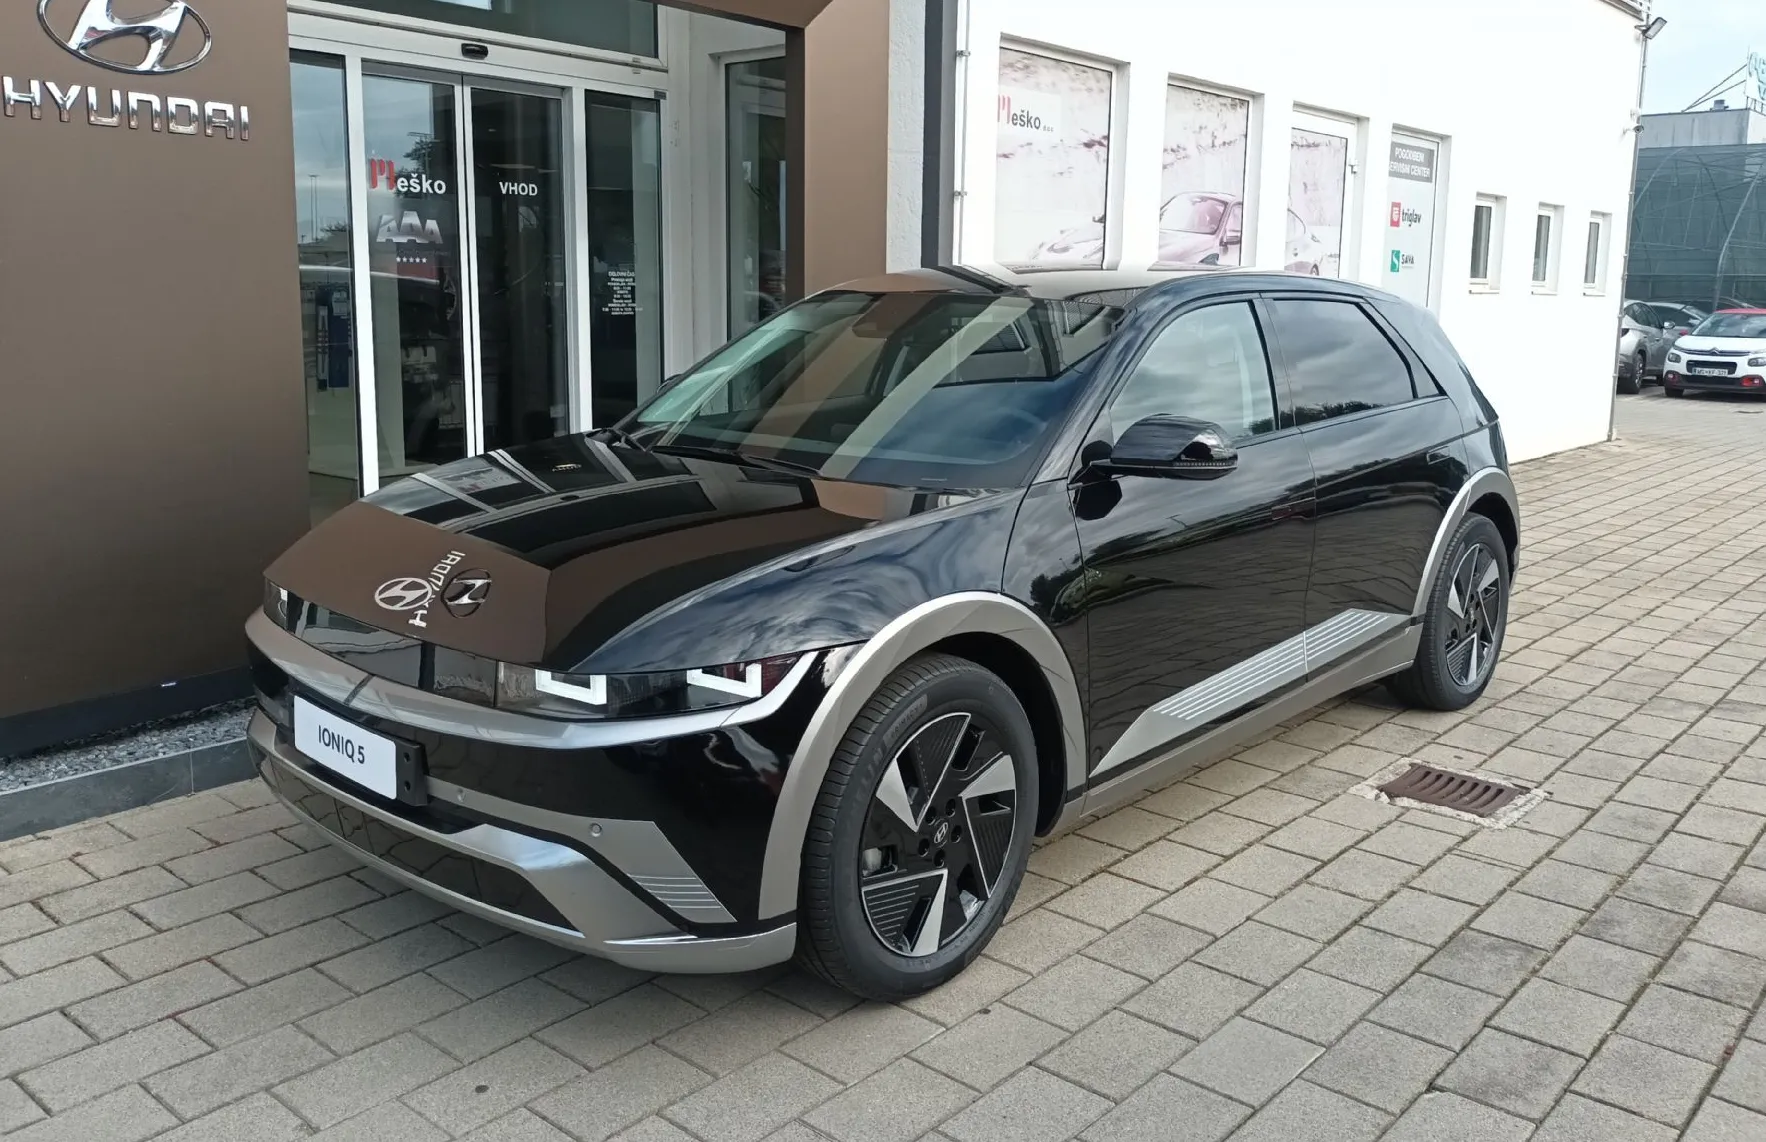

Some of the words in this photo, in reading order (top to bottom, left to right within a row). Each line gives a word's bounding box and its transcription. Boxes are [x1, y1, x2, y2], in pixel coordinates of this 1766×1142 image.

[1, 75, 249, 141] HYUNDAI
[370, 158, 447, 195] Meško
[499, 181, 538, 196] VHOD
[1402, 208, 1422, 227] triglav
[318, 725, 355, 763] IONIQ
[357, 746, 366, 765] 5
